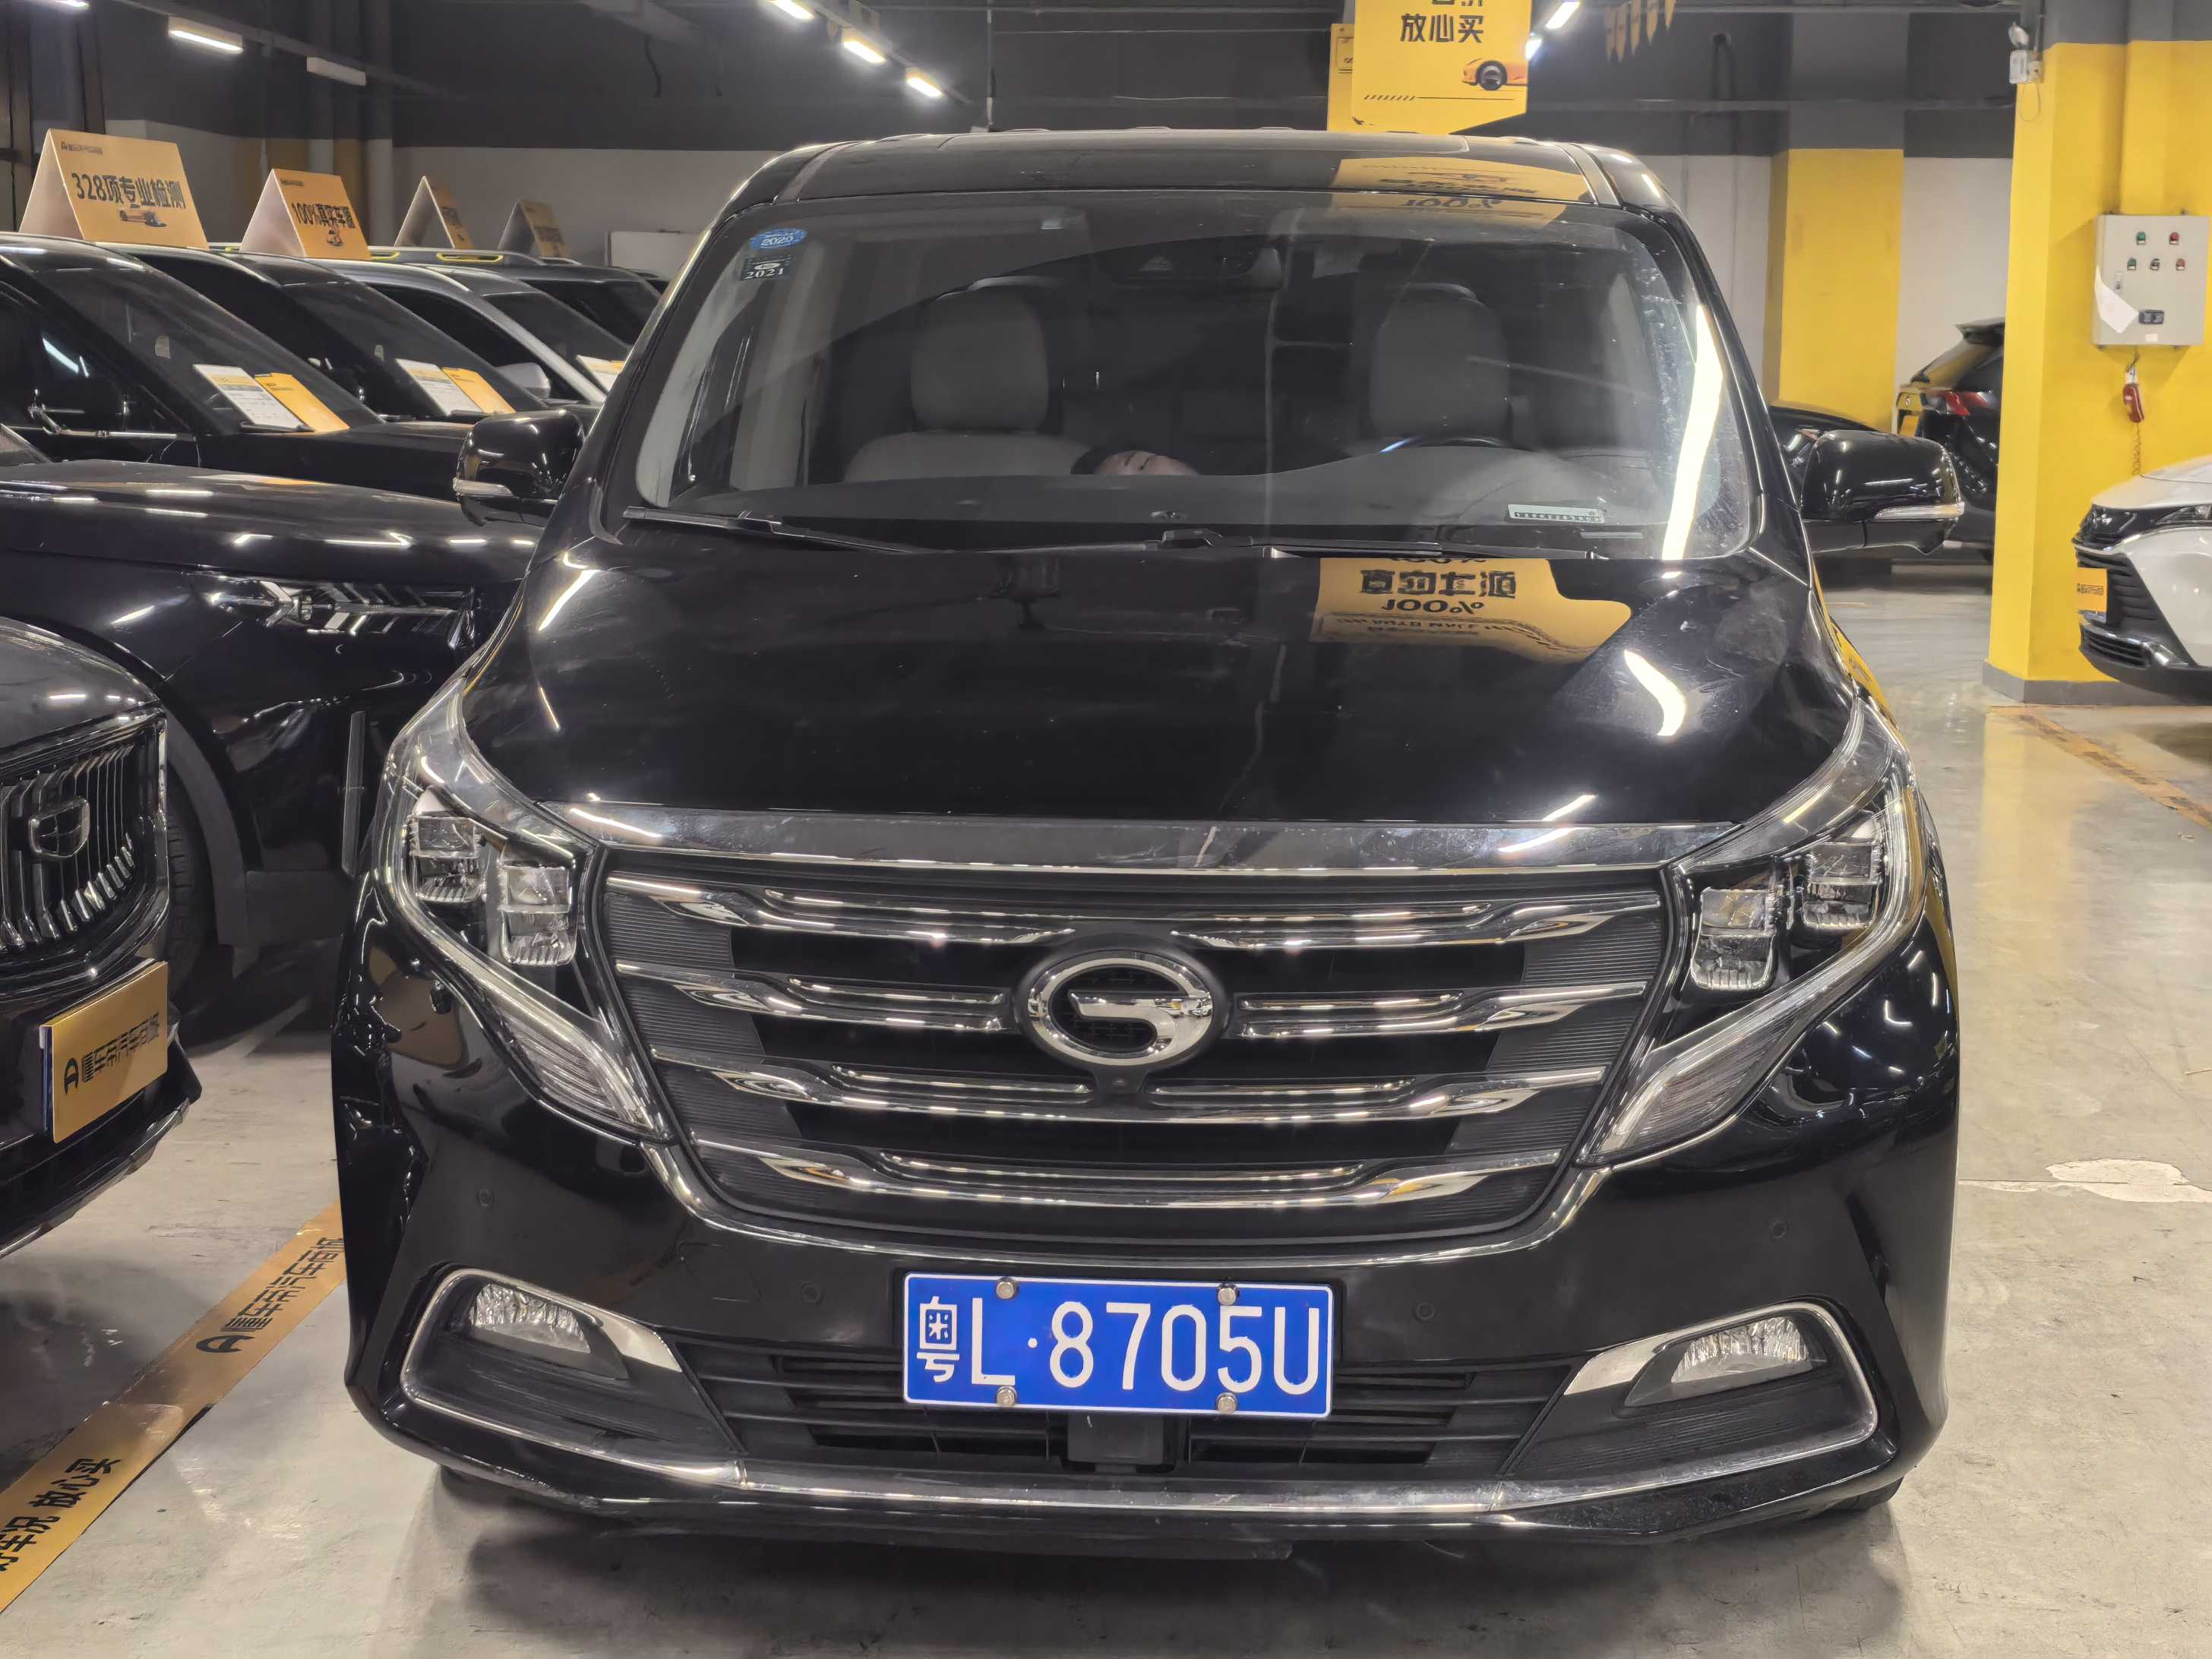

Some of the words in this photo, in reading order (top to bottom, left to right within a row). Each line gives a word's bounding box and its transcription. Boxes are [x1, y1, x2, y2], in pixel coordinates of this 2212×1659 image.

[1400, 13, 1484, 43] 放心买
[71, 172, 186, 209] 328项专业检测
[744, 267, 785, 280] 2021
[28, 1458, 122, 1509] 放心买
